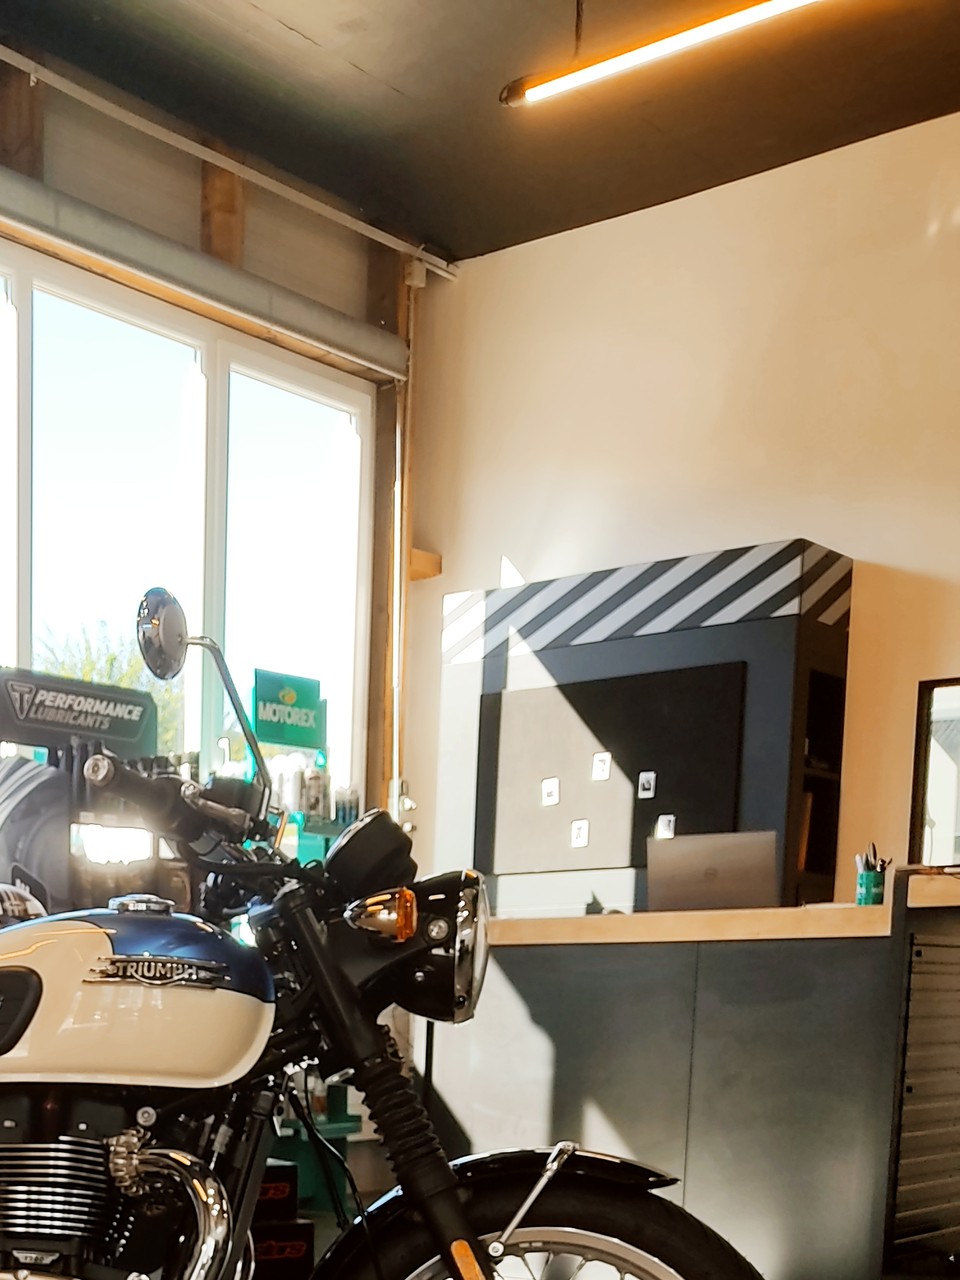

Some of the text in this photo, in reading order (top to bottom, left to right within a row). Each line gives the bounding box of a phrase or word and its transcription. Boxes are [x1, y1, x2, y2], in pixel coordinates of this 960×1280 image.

[29, 705, 112, 730] LUBRICANTS
[34, 690, 144, 721] PERFORMANCE
[258, 701, 316, 728] MOTOREX
[115, 961, 197, 980] TRIUMPH
